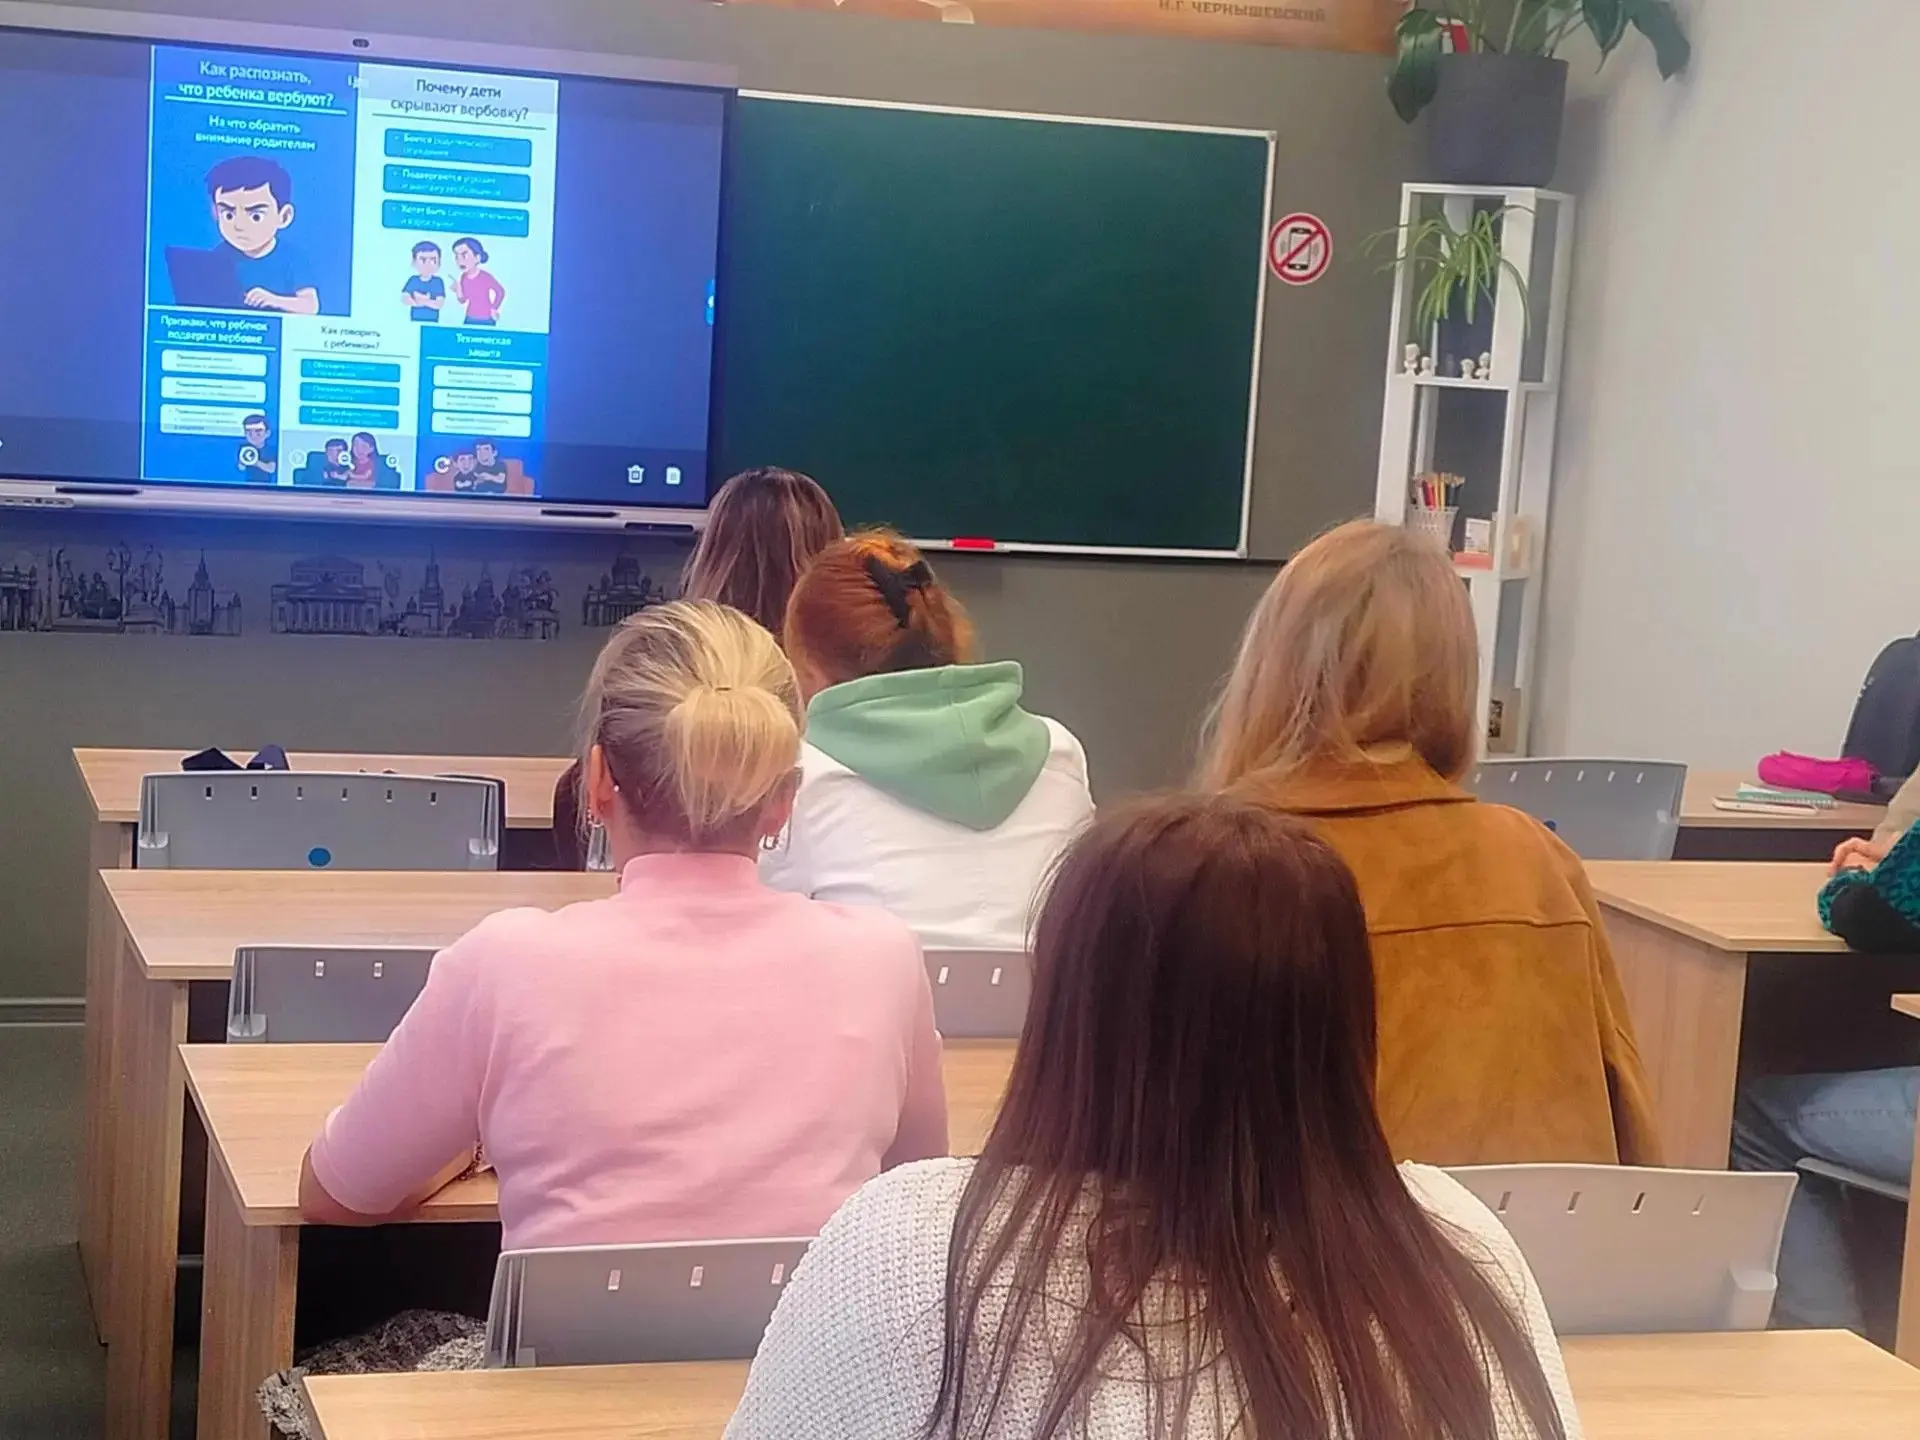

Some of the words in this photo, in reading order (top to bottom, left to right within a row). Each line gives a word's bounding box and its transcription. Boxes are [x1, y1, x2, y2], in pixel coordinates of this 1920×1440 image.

[1191, 2, 1327, 22] ЧЕРНЫШЕВСКИЙ
[200, 61, 227, 77] Как
[229, 65, 312, 85] распознать,
[178, 83, 203, 96] что
[206, 83, 265, 101] ребенка
[267, 89, 335, 107] вербуют?
[416, 78, 468, 97] Почему
[469, 85, 502, 99] дети
[391, 99, 458, 114] скрывают
[460, 103, 529, 122] вербовку?
[209, 114, 225, 128] На
[226, 120, 246, 130] что
[248, 118, 301, 134] обратить
[195, 132, 251, 146] внимание
[253, 136, 317, 151] родителям
[209, 320, 228, 330] что
[321, 325, 338, 336] Как
